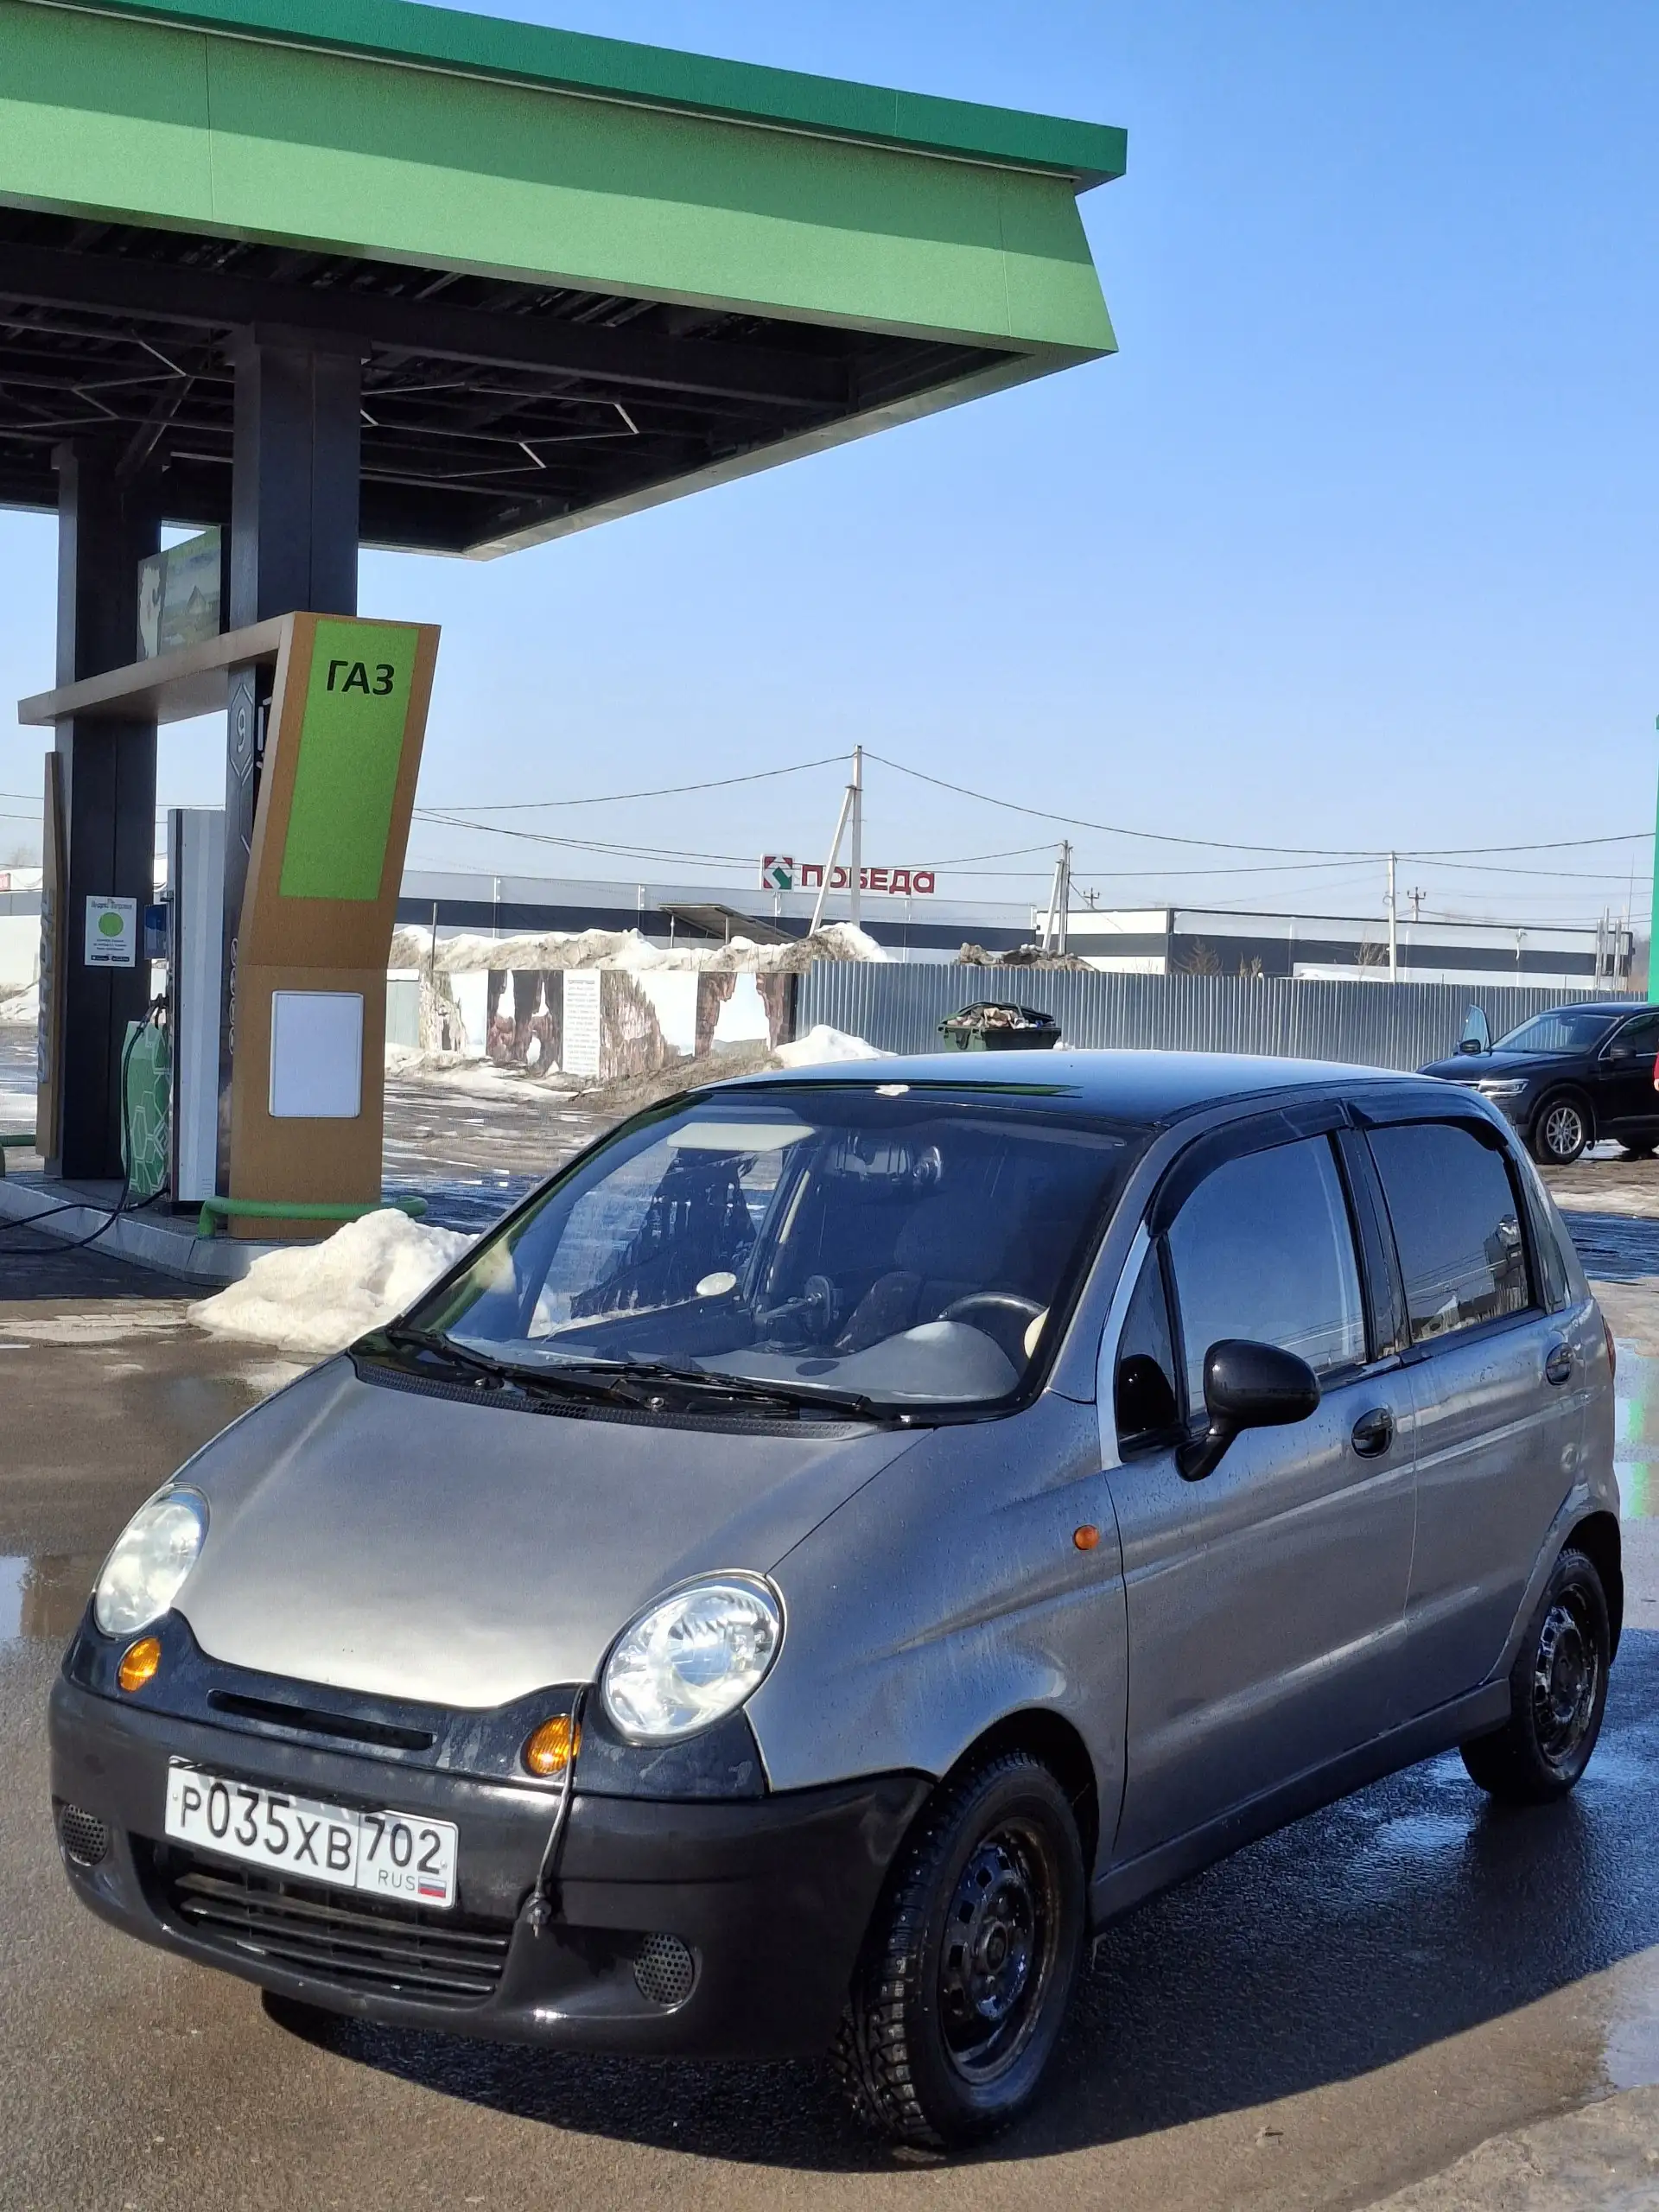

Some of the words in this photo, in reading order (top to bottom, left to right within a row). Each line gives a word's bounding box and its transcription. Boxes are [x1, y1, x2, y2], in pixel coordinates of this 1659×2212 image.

[326, 659, 395, 696] ГАЗ
[237, 708, 246, 753] 9
[377, 1869, 416, 1891] RUS
